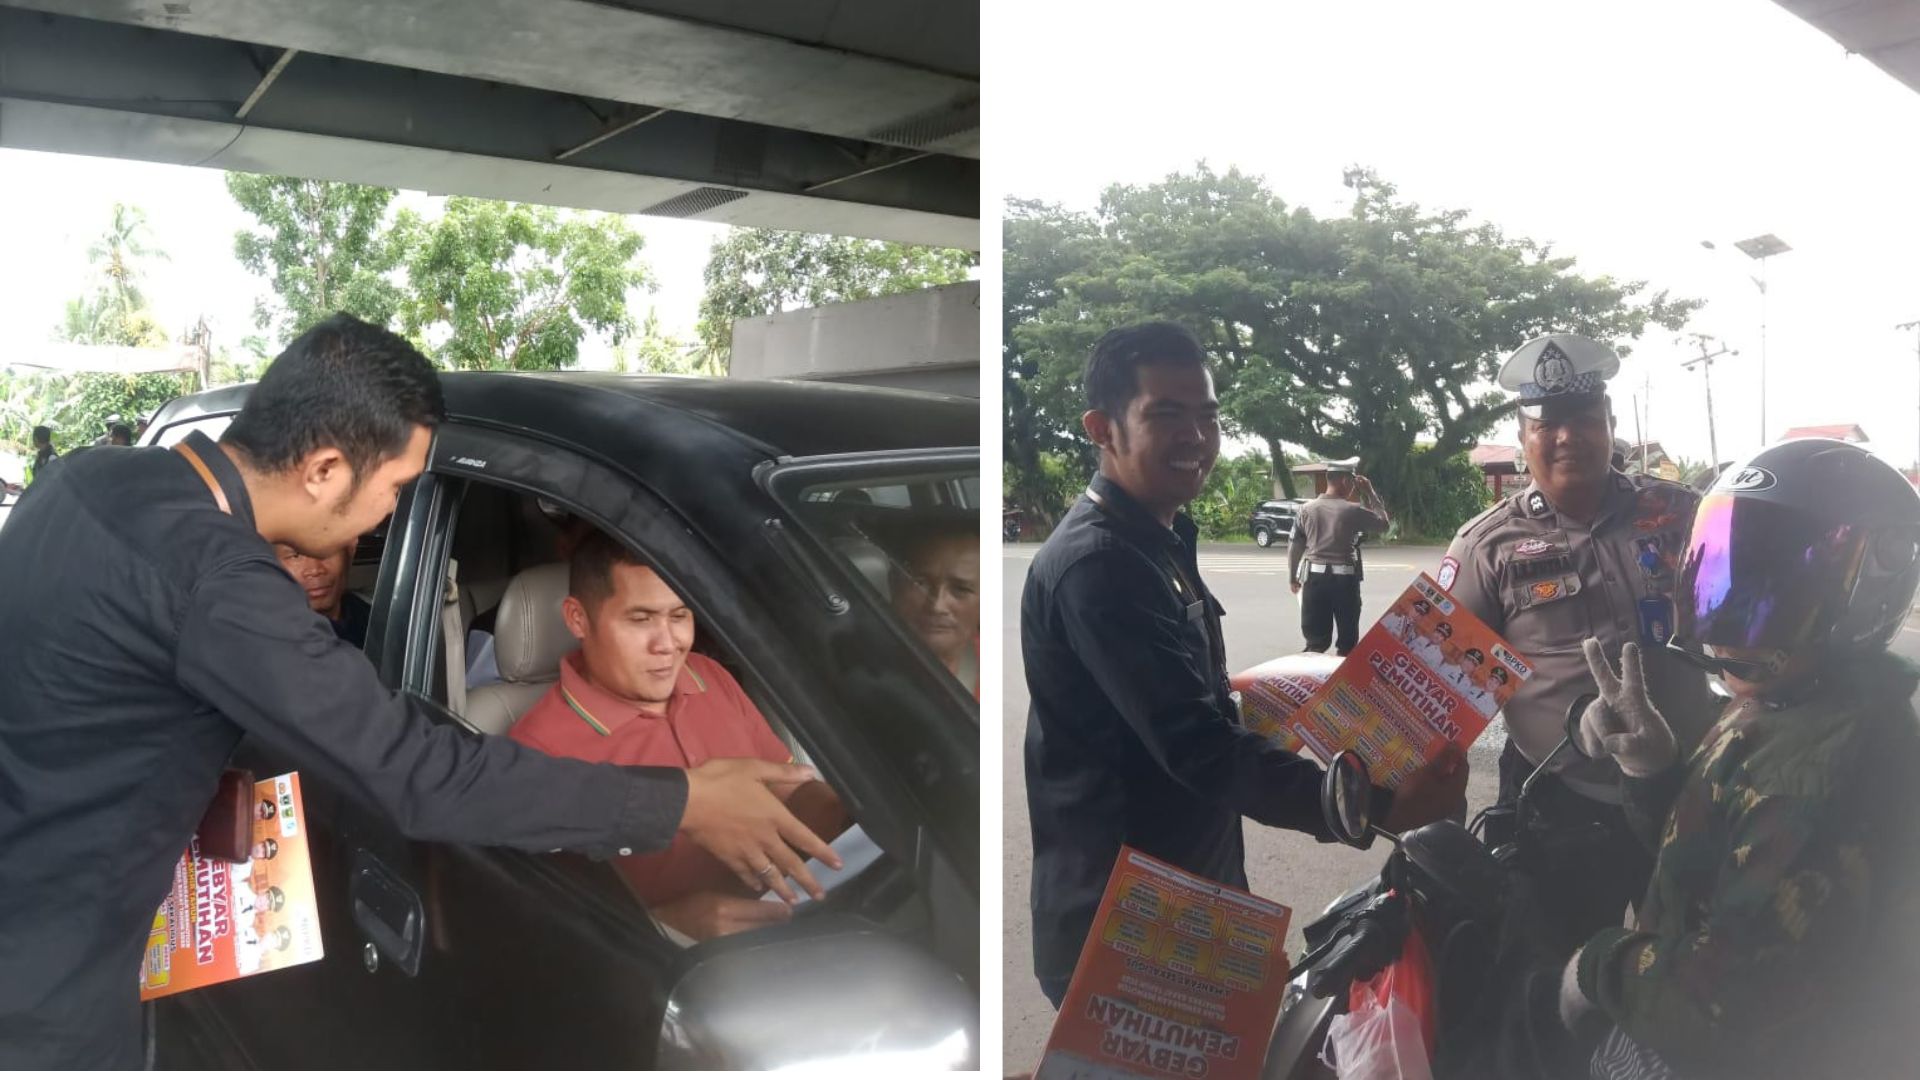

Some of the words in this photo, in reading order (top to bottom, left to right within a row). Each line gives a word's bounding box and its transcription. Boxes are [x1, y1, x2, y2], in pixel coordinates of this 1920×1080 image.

[1394, 652, 1457, 711] GEBYAR
[1504, 653, 1526, 672] BPKD
[1370, 652, 1461, 740] PEMUTIHAN
[194, 849, 212, 962] MUTIHAN
[211, 859, 227, 935] EBYAR
[1087, 995, 1239, 1058] PEMUTIHAN
[1103, 1032, 1208, 1078] GEBYAR
